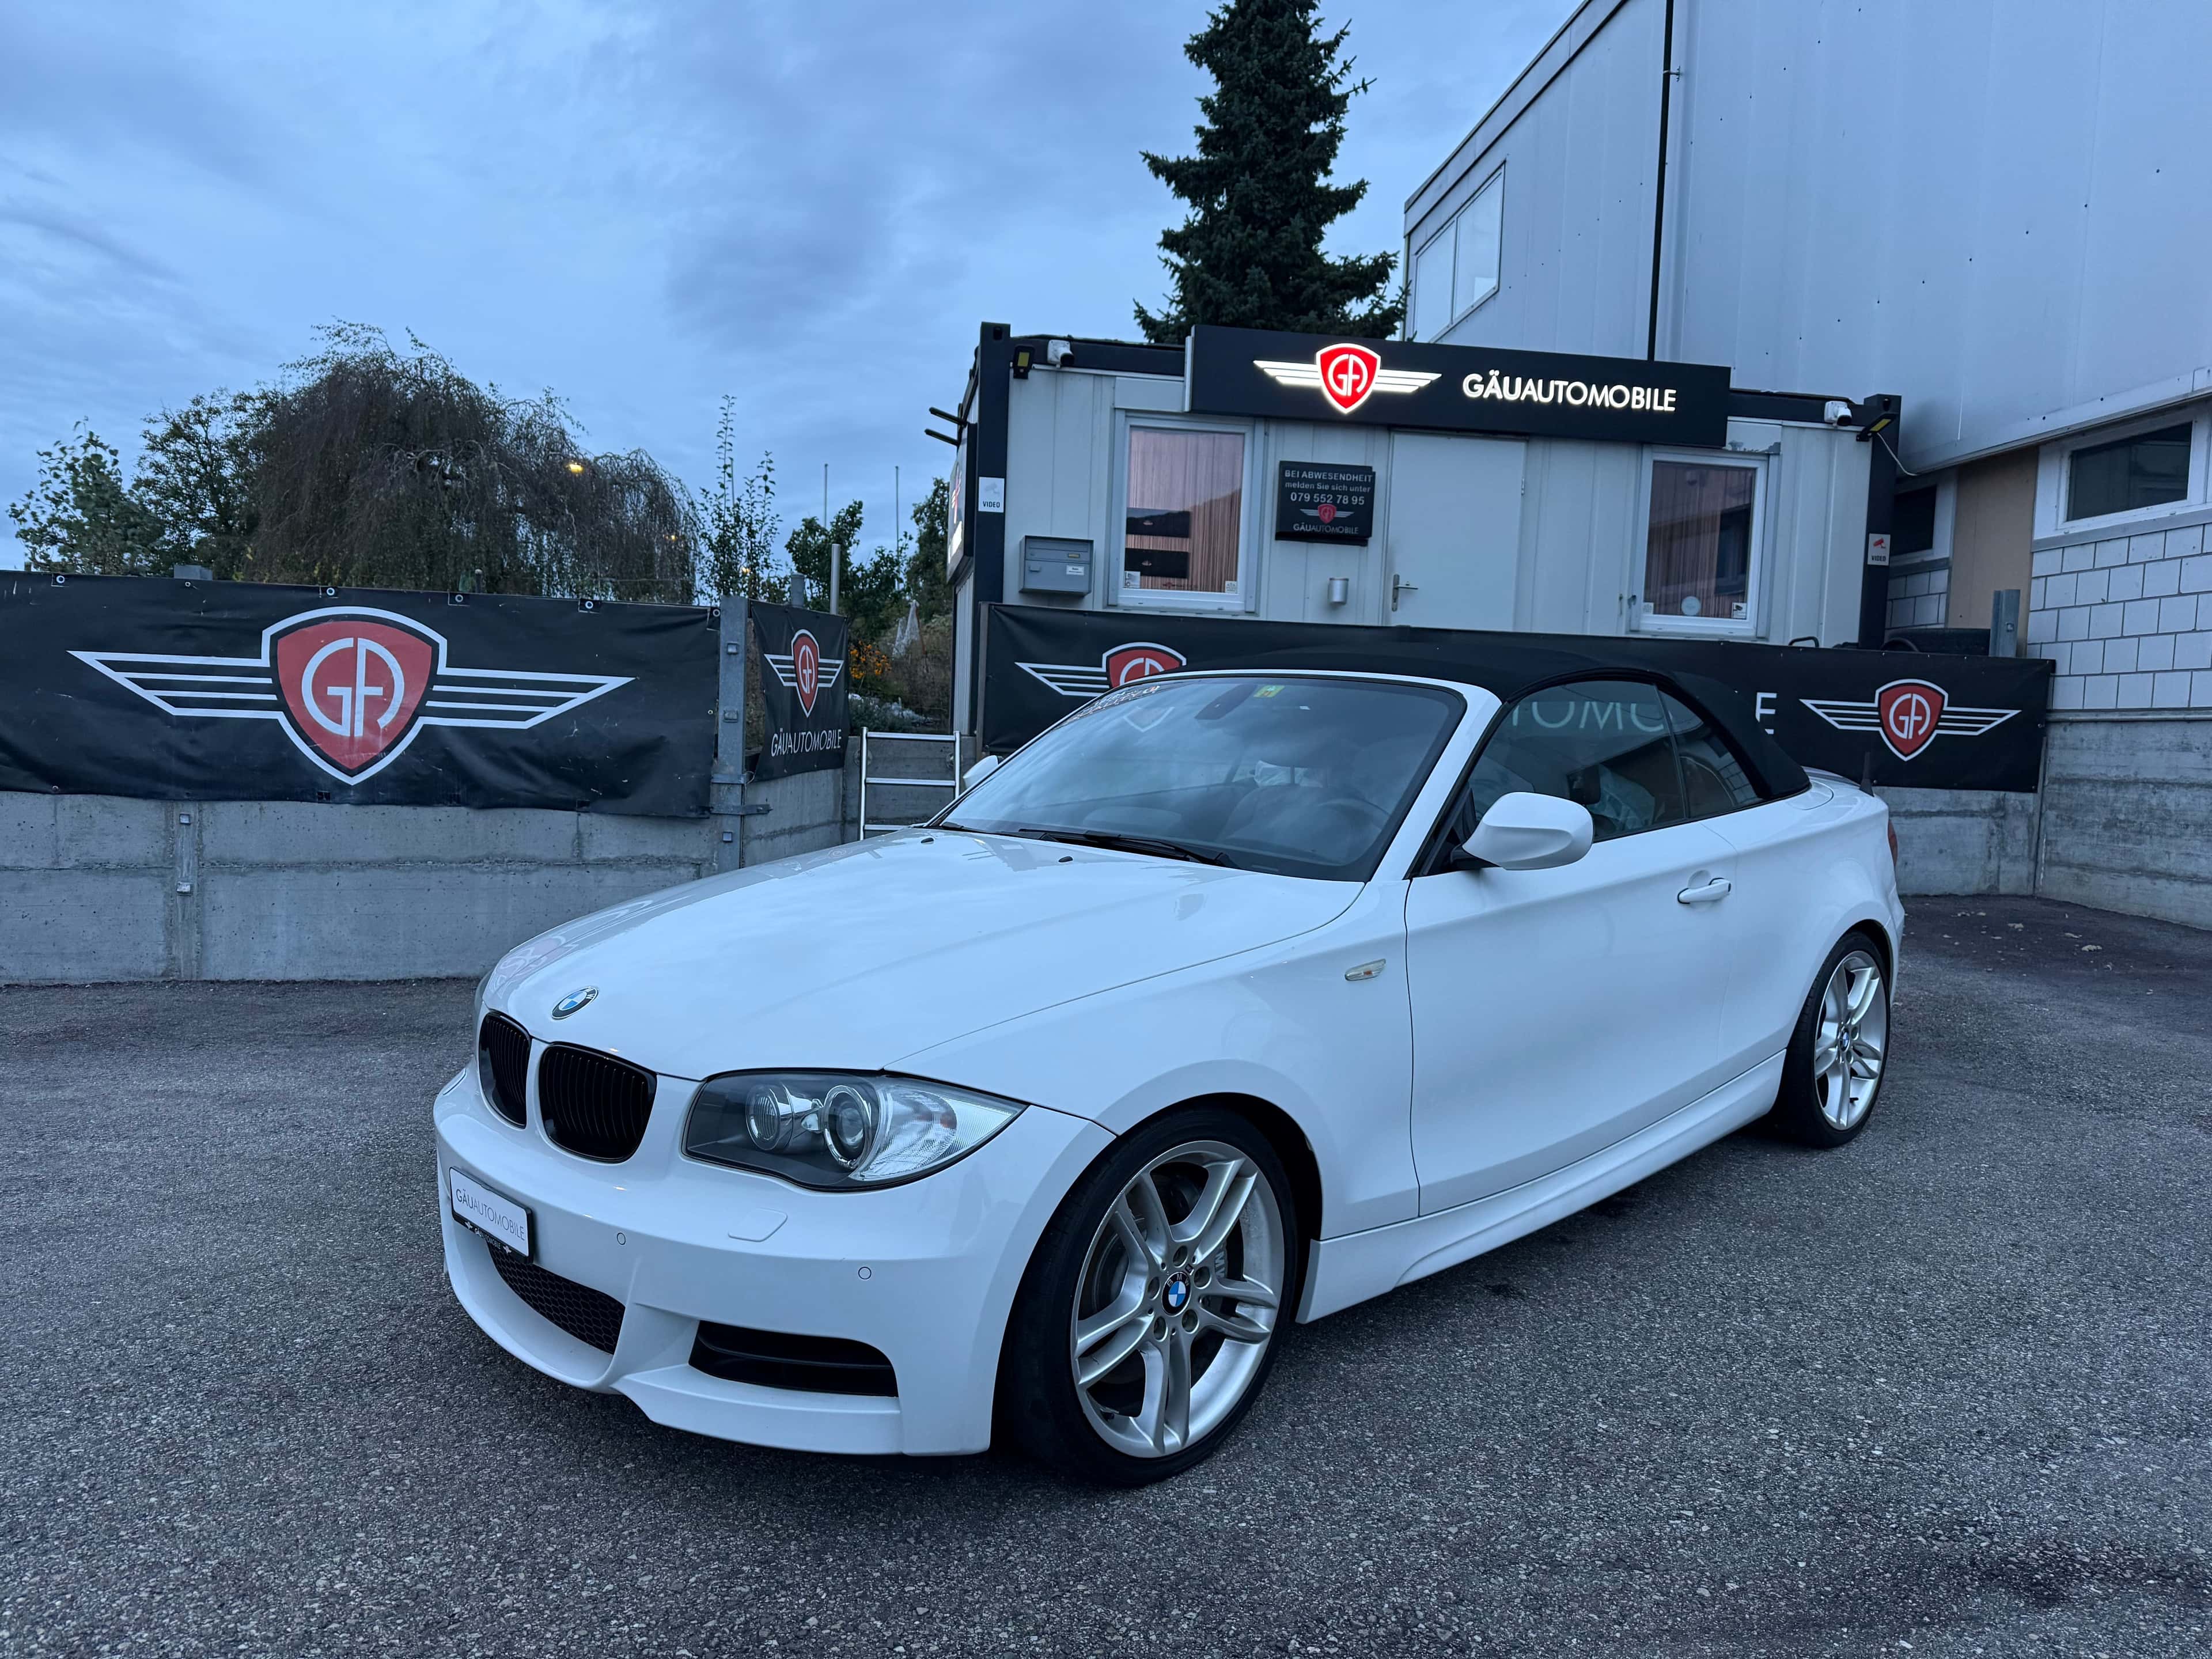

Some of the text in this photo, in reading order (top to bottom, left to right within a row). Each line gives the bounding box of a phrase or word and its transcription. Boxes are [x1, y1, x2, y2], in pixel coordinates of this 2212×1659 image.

[1462, 369, 1677, 412] GÄUAUTOMOBILE
[1285, 469, 1373, 482] BEI ABWESENDHEIT
[1290, 493, 1365, 505] 079 552 78 95
[771, 728, 842, 757] GÄUAUTOMOBILE
[456, 1188, 525, 1242] GÄUAUTOMOBILE
